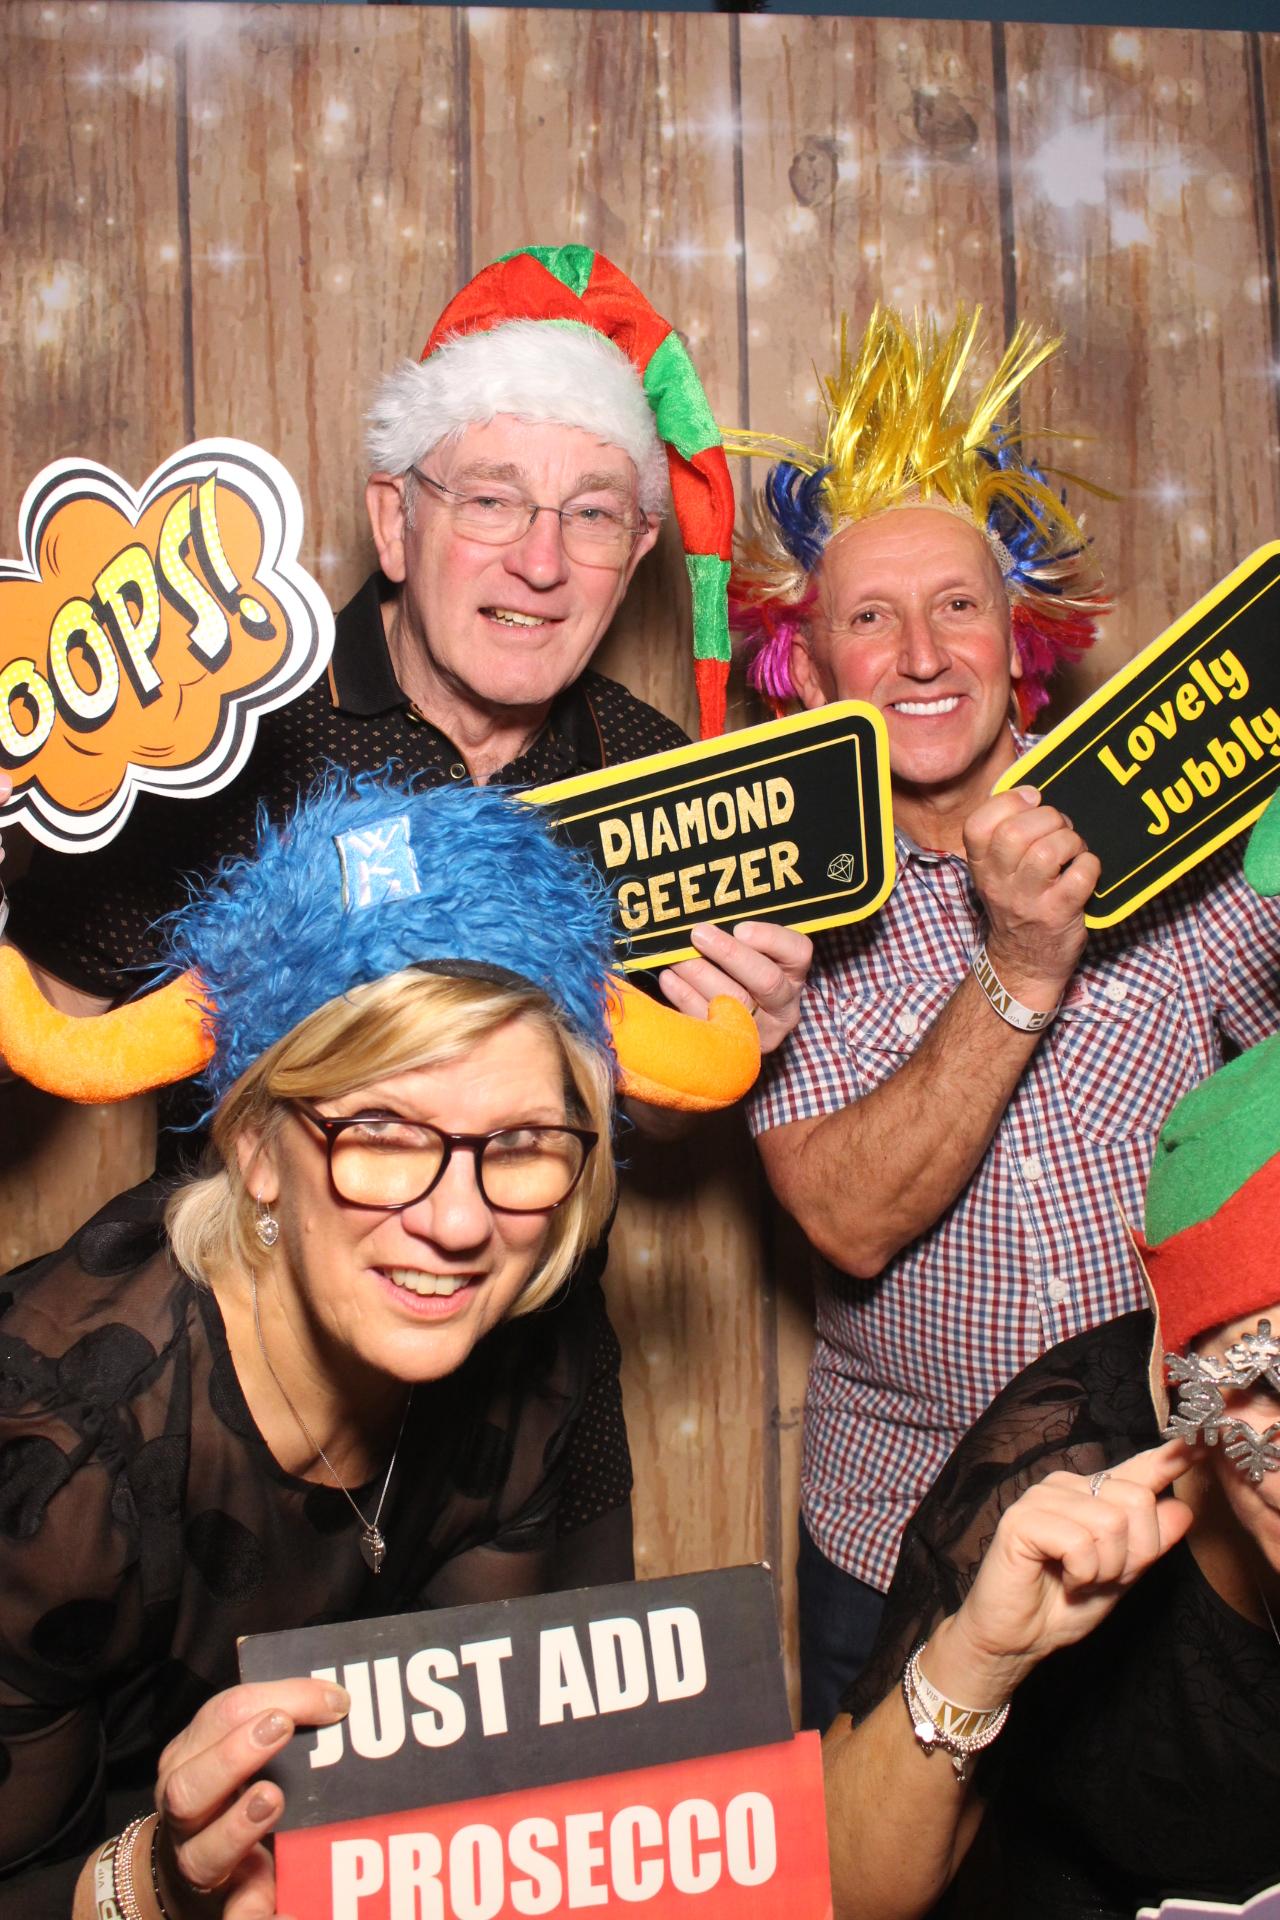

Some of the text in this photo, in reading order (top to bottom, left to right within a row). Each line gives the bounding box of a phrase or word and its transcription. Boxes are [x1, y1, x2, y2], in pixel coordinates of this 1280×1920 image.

[0, 473, 269, 760] OOPS!
[1097, 648, 1250, 787] Lovely
[1141, 706, 1280, 836] Jubbly
[599, 776, 795, 868] DIAMOND
[617, 840, 803, 930] GEEZER
[309, 1606, 707, 1769] JUST ADD
[331, 1791, 777, 1920] PROSECCO
